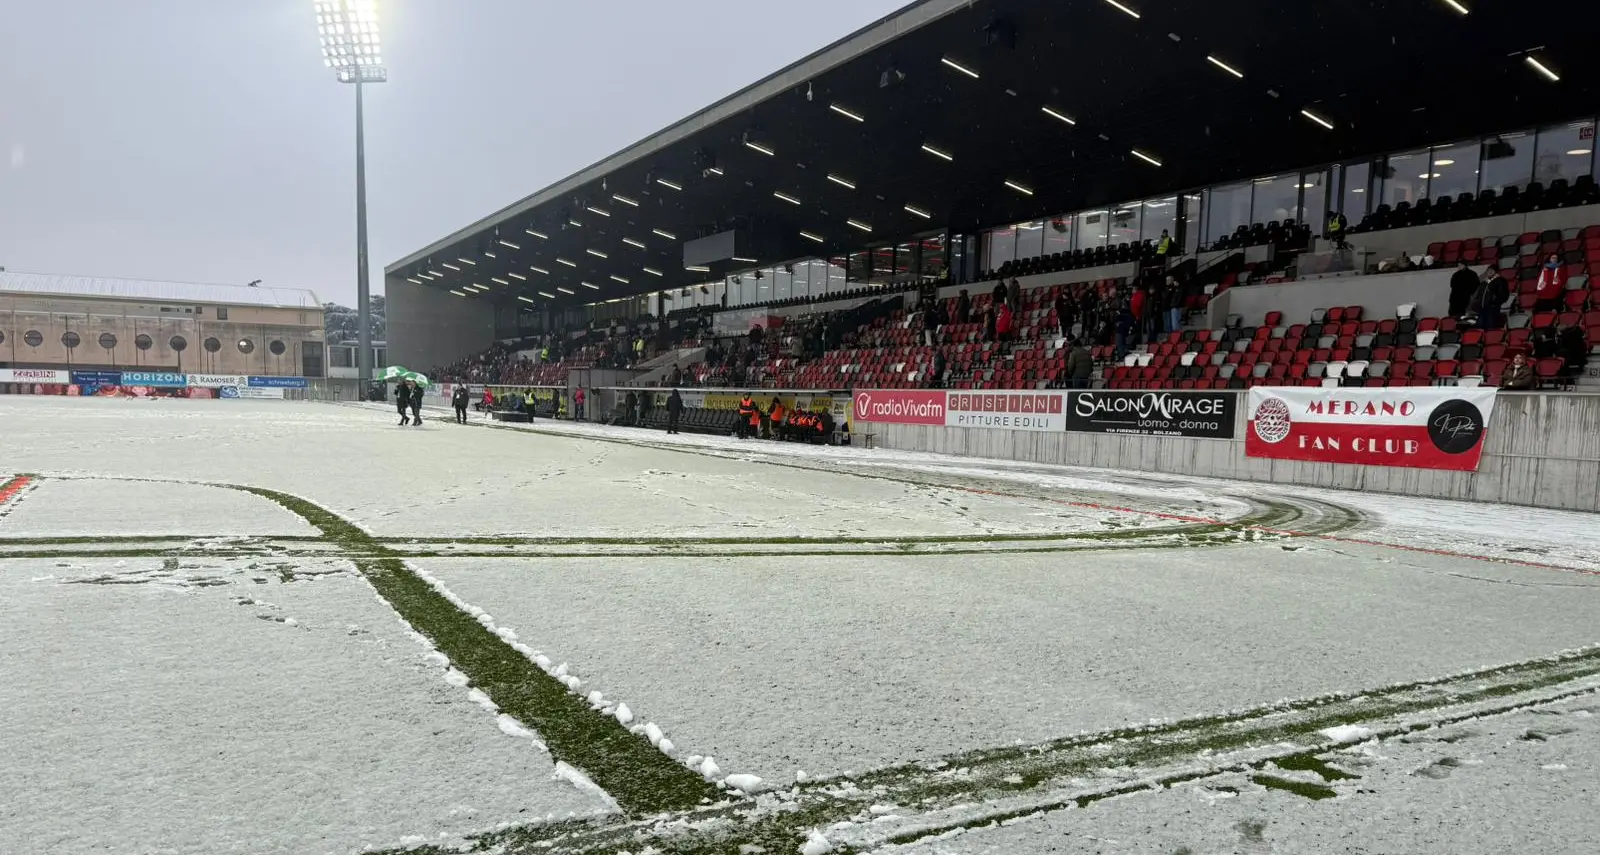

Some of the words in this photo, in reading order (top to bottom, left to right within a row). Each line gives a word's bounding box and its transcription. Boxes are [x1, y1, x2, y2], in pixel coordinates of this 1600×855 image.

[122, 372, 184, 382] HORIZON
[200, 376, 235, 385] RAMOSER
[872, 398, 943, 418] radioVivafm
[951, 397, 1058, 410] CRISTIANI
[1075, 392, 1140, 417] SALON
[1140, 392, 1224, 419] MIRAGE
[1305, 400, 1416, 417] MERANO
[958, 415, 1009, 426] PITTURE
[1014, 416, 1050, 428] EDILI
[1138, 419, 1169, 428] uomo
[1180, 419, 1219, 430] donna
[1298, 435, 1341, 450] FAN
[1352, 437, 1419, 454] CLUB
